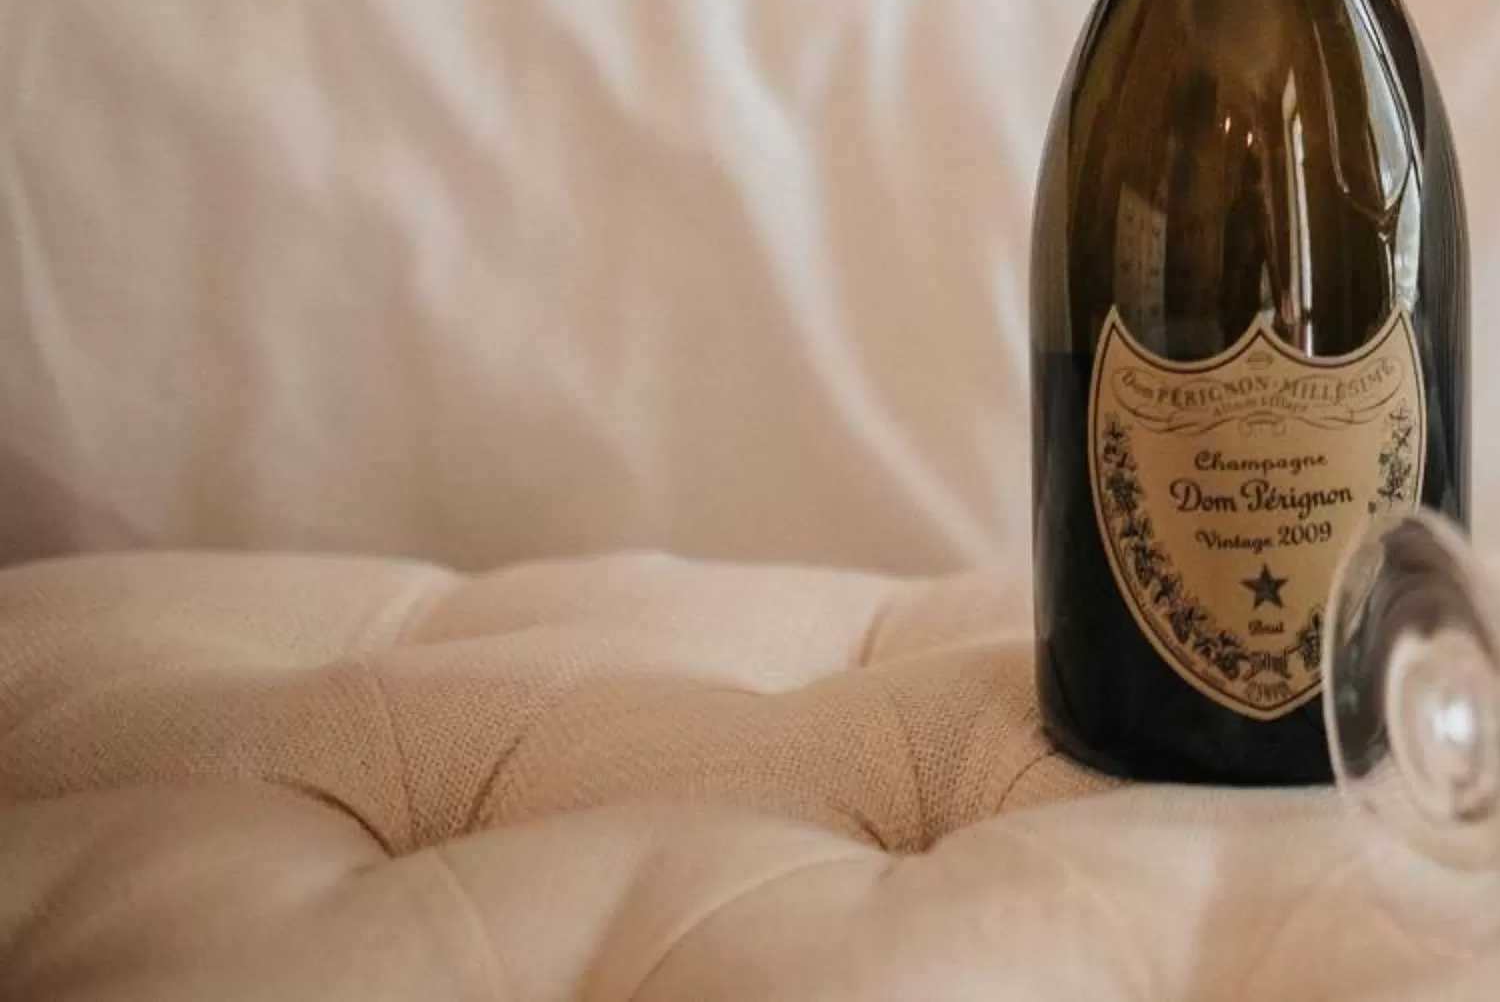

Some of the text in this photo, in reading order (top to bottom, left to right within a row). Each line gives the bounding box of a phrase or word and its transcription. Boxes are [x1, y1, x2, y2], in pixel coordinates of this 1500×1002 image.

[1194, 451, 1328, 476] Champagne
[1169, 477, 1354, 520] Dom Pérignon
[1195, 521, 1333, 555] Vintage 2009
